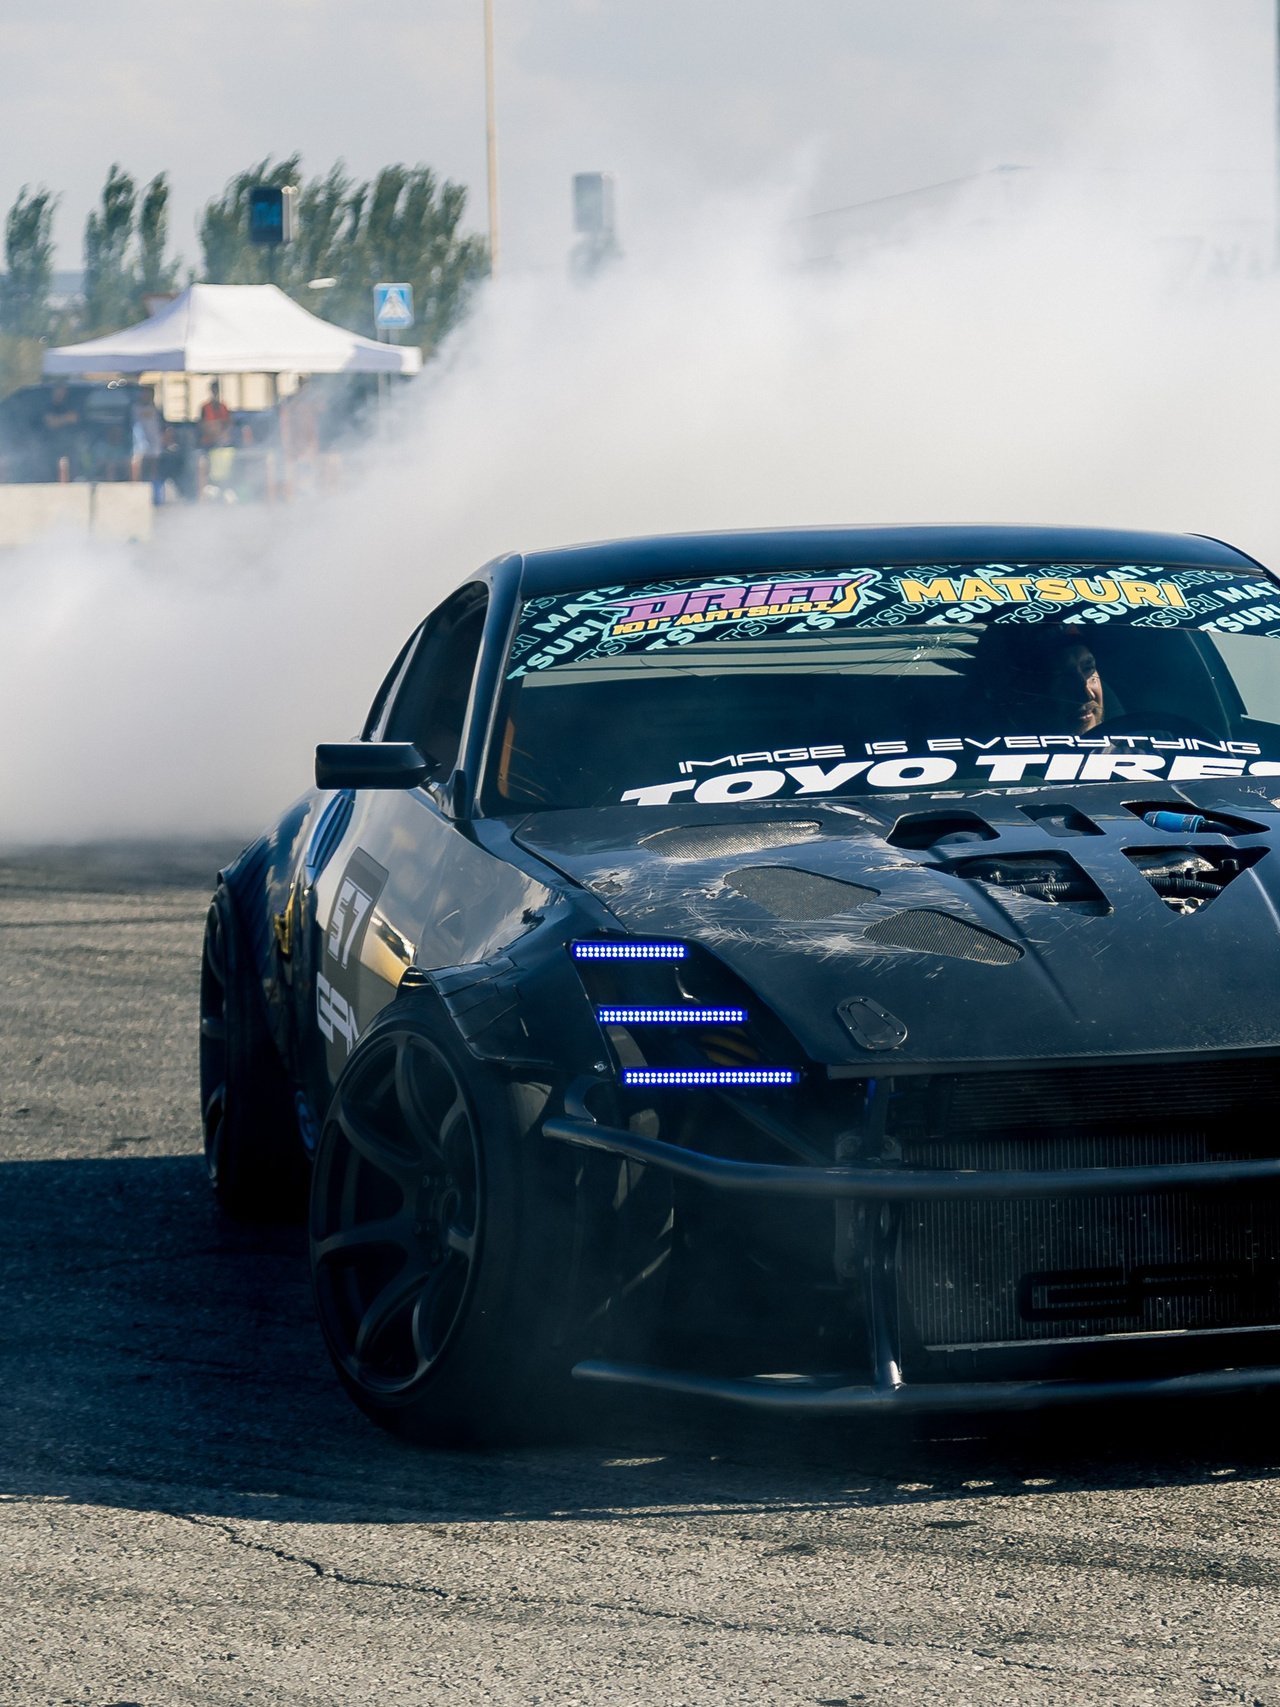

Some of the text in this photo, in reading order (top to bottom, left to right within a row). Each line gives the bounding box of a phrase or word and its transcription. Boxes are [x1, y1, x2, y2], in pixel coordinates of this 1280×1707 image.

[900, 578, 1187, 607] MATSURI
[674, 601, 834, 626] MATSURI
[678, 745, 846, 774] IMAGE
[865, 741, 908, 755] IS
[620, 757, 957, 806] TOYO
